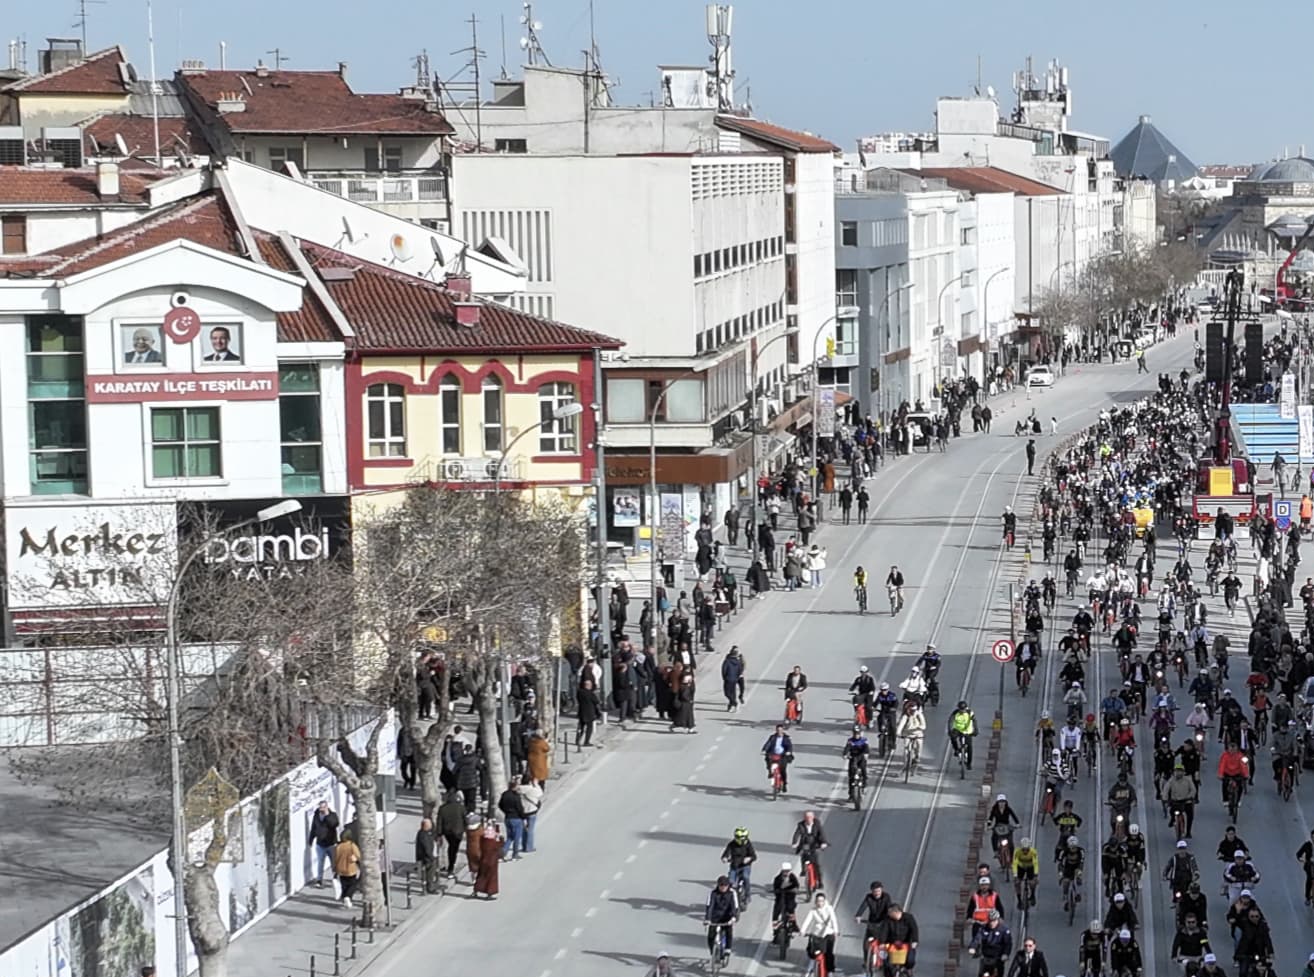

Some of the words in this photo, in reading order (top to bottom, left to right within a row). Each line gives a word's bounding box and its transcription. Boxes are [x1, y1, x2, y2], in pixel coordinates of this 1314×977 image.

[94, 382, 160, 393] KARATAY
[163, 379, 196, 394] İLÇE
[199, 378, 272, 394] TEŞKİLATI
[19, 521, 165, 557] Merkez
